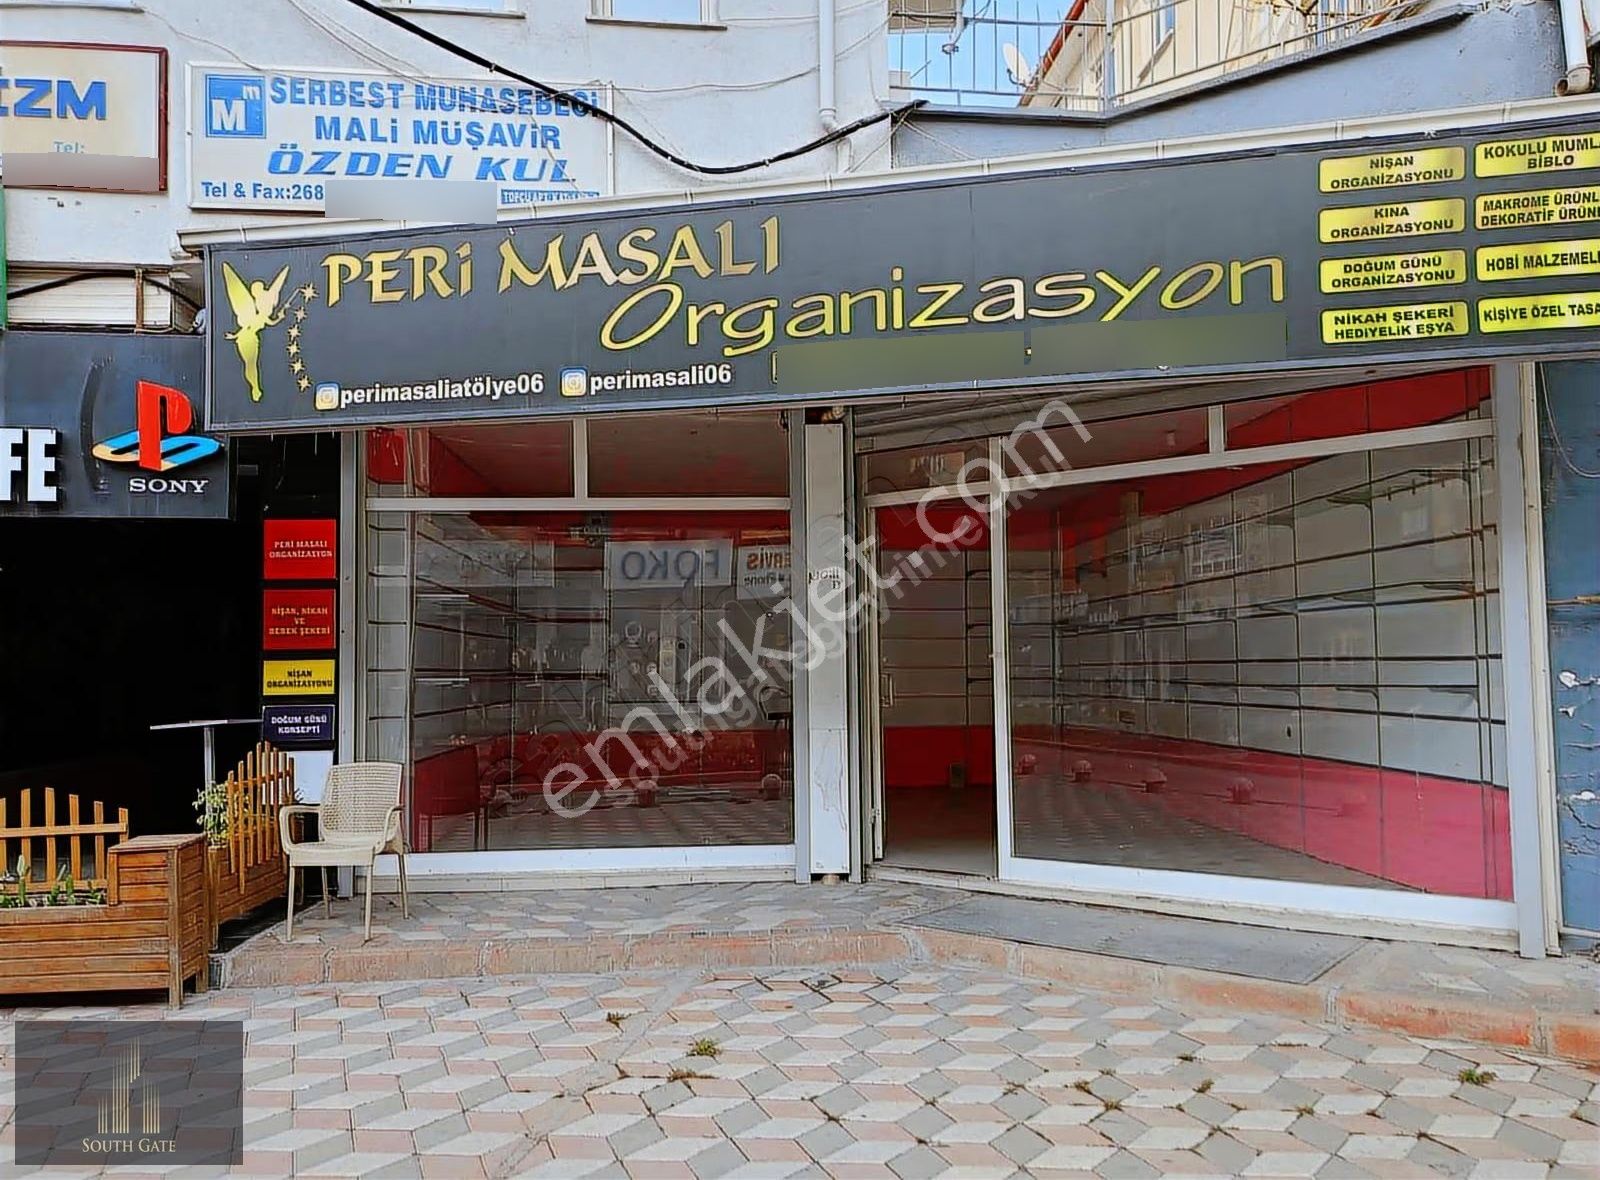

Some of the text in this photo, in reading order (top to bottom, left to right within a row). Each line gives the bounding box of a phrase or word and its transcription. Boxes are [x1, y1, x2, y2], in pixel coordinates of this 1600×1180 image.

[270, 77, 404, 109] SERBEST
[1484, 141, 1547, 159] KOKULU
[268, 143, 453, 179] ÖZDEN
[1370, 156, 1414, 169] NİŞAN
[1527, 154, 1575, 169] BİBLO
[1330, 168, 1454, 189] ORGANİZASYONU
[201, 182, 227, 198] Tel
[233, 183, 246, 198] &
[1374, 207, 1410, 219] KINA
[1483, 195, 1550, 212] MAKROME
[1481, 208, 1555, 227] DEKORATİF
[1330, 218, 1454, 239] ORGANİZASYONU
[498, 215, 780, 294] MASALI
[1486, 250, 1600, 272] HOBİ MALZEMEL
[1343, 256, 1442, 274] DOĞUM GÜNÜ
[1331, 269, 1456, 289] ORGANİZASYONU
[600, 256, 1286, 357] Organizasyon
[1334, 305, 1455, 325] NİKAH ŞEKERİ
[1483, 307, 1527, 323] KİŞİYE
[1531, 304, 1566, 318] ÖZEL
[1416, 322, 1455, 337] EŞYA
[590, 364, 732, 395] perimasali06
[340, 373, 544, 409] perimasaliatölye06
[128, 478, 209, 494] SONY
